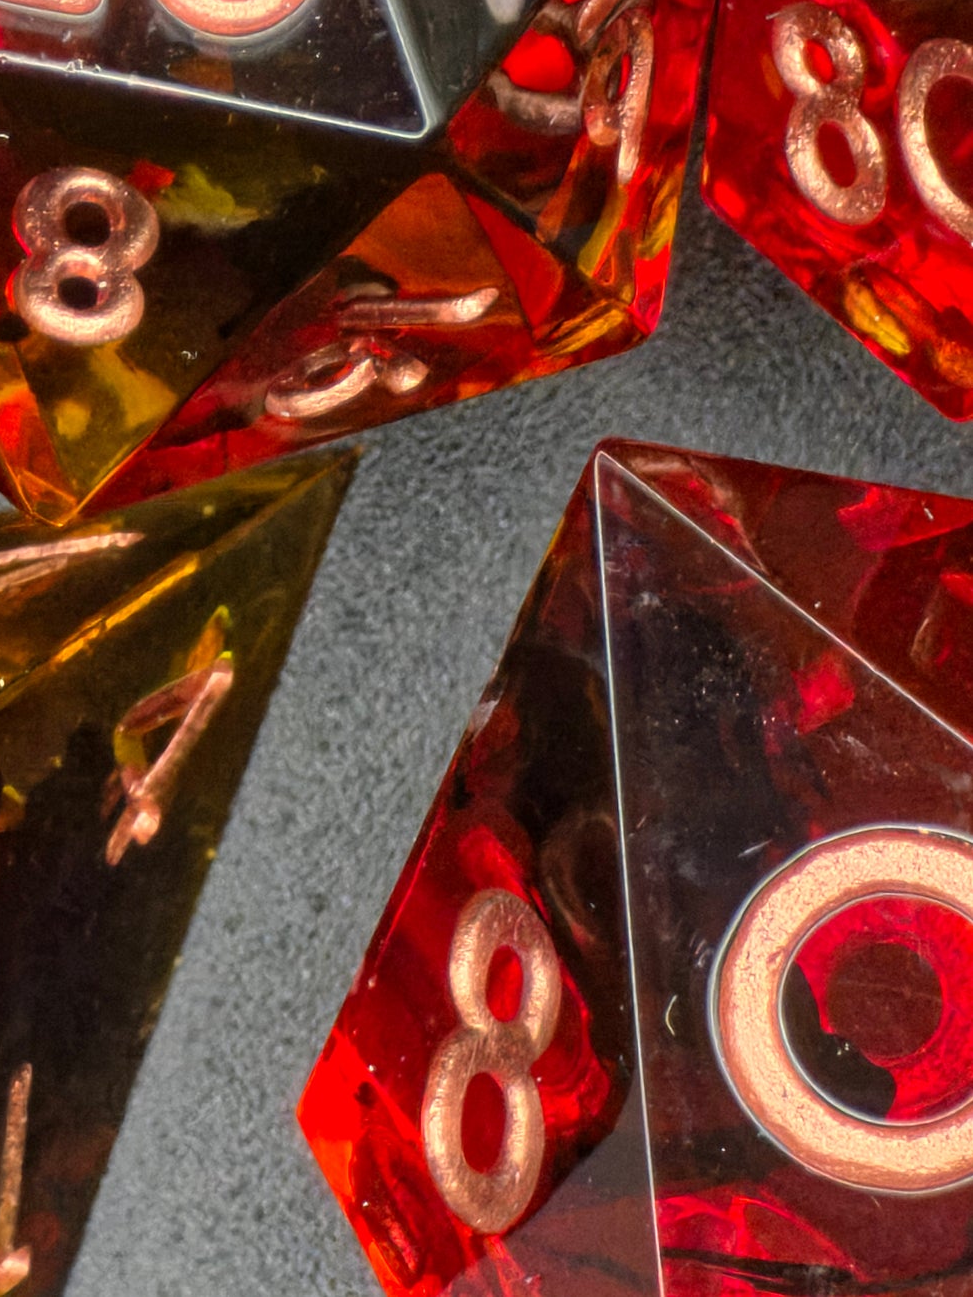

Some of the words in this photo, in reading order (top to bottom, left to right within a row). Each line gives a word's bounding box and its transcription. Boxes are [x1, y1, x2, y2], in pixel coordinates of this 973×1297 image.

[12, 167, 160, 346] 8
[421, 888, 562, 1236] 8
[713, 827, 973, 1193] 0
